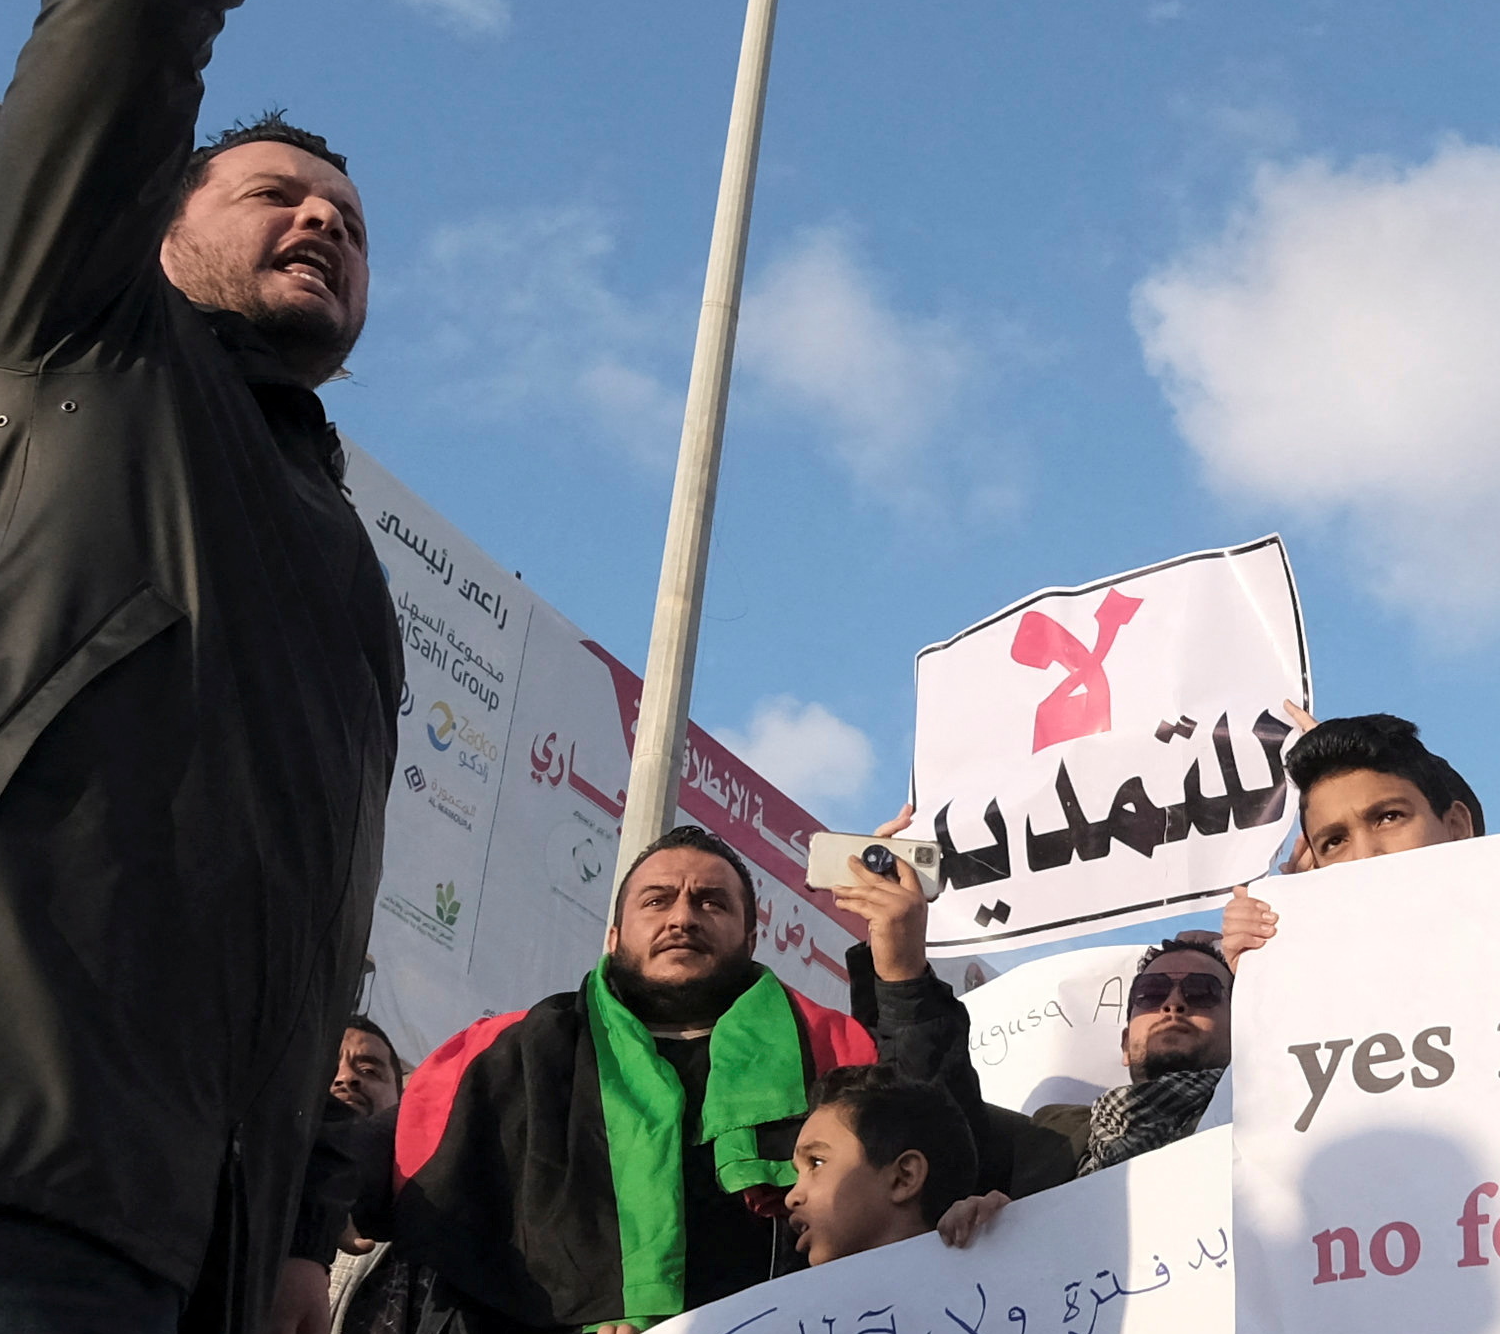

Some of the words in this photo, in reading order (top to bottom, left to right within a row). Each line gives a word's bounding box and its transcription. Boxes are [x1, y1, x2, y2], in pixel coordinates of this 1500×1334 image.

[376, 510, 454, 585] رئيسي
[398, 591, 445, 637] السهل
[458, 578, 508, 630] راعي
[446, 628, 504, 683] مجموعة
[451, 658, 500, 712] Group
[1010, 587, 1144, 755] لا
[458, 716, 498, 762] Zadco
[934, 708, 1292, 928] للتمديد
[1288, 1022, 1456, 1133] yes
[1312, 1216, 1422, 1286] no
